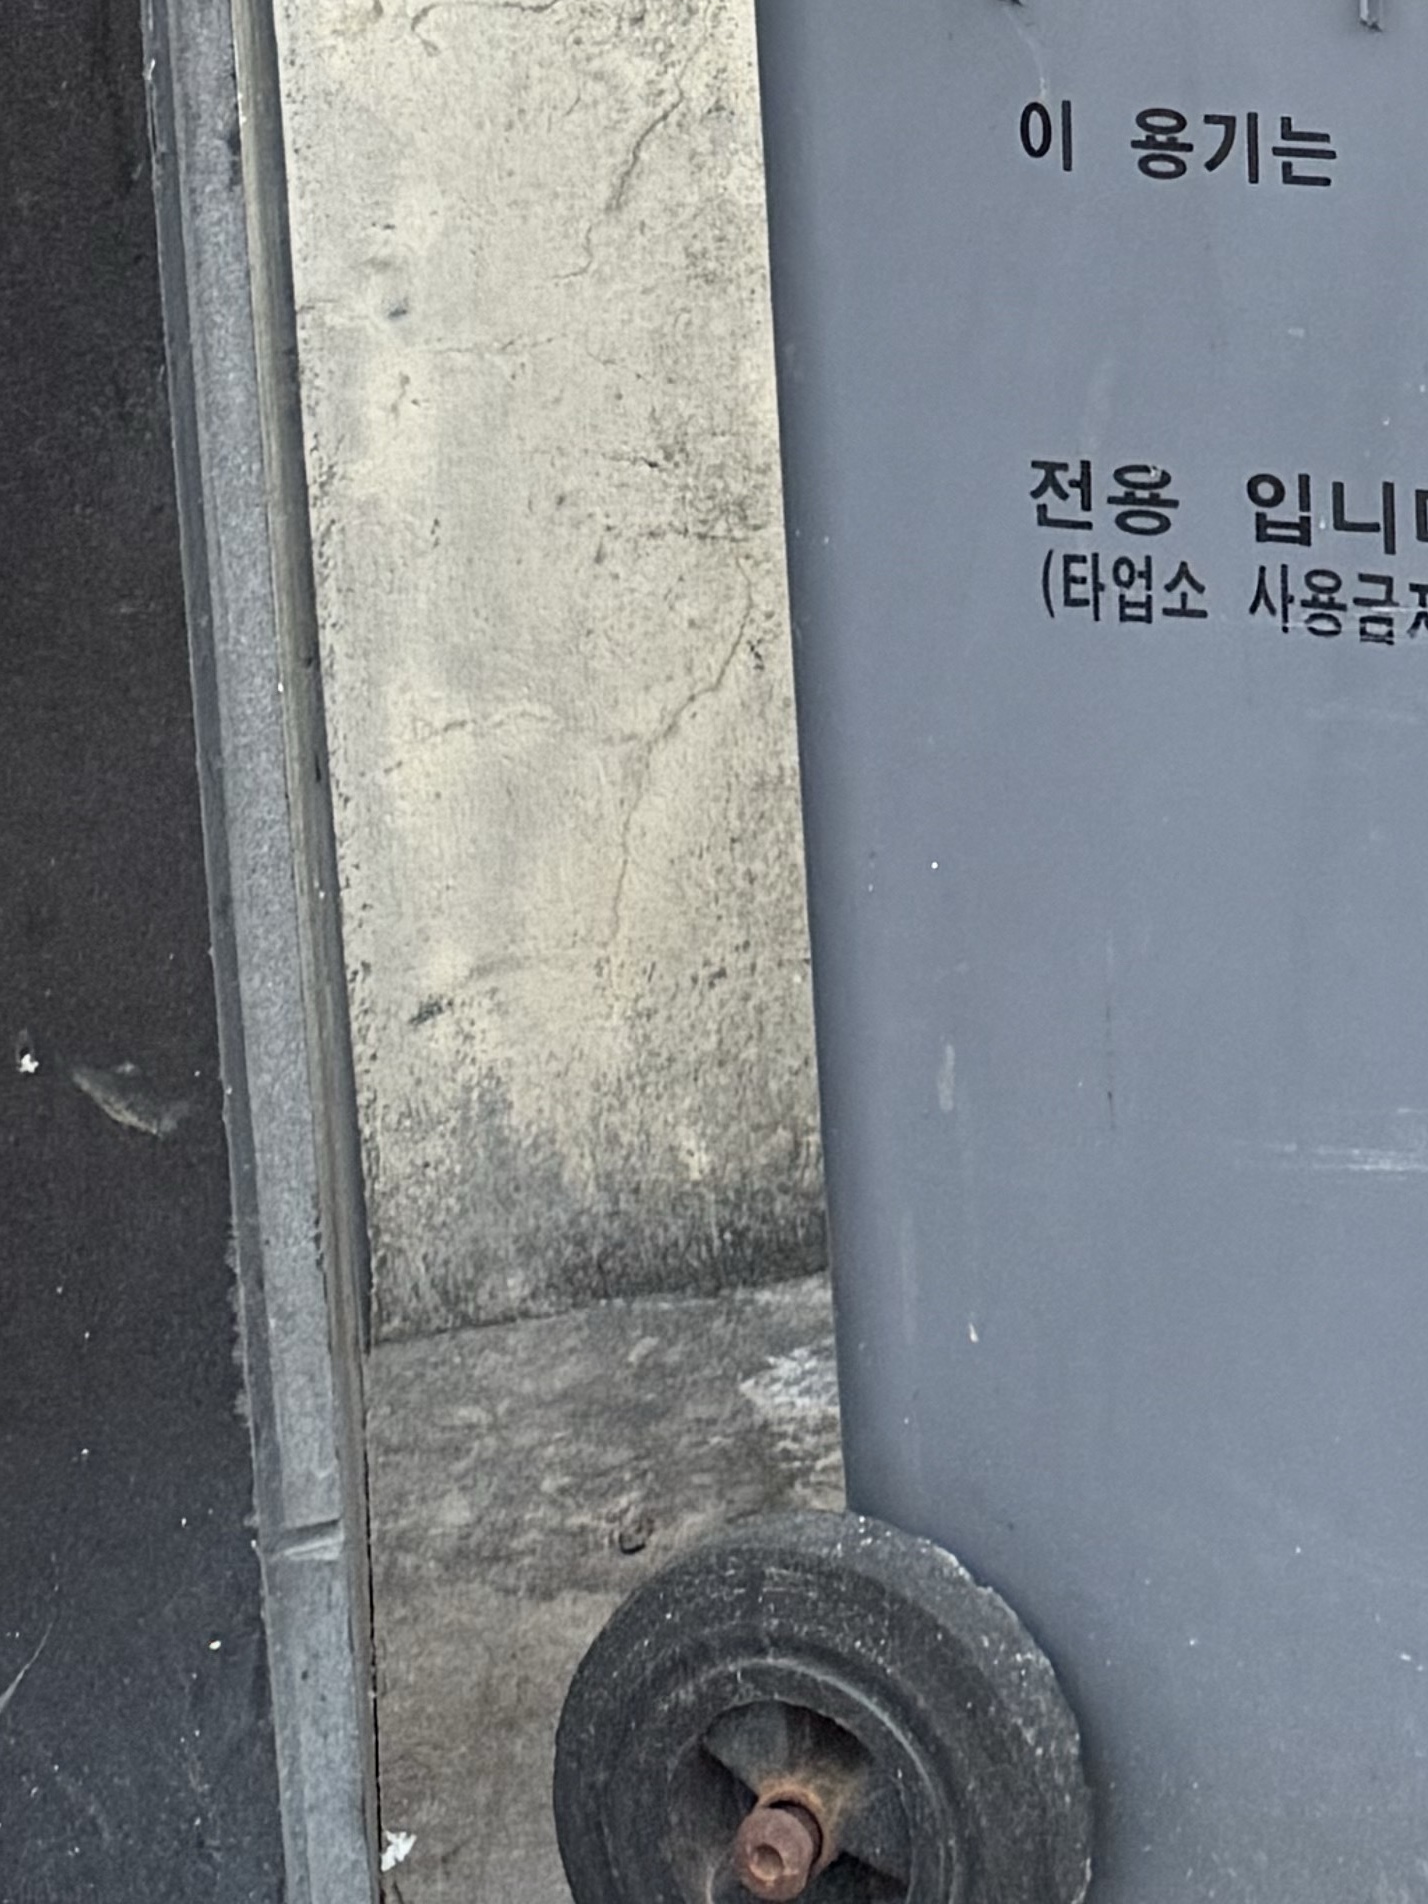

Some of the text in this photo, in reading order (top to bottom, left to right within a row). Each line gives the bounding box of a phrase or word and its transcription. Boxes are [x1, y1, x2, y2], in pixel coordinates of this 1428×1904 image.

[1020, 100, 1337, 187] 이 용기는
[1029, 459, 1180, 536] 전용
[1041, 548, 1208, 623] (타업소
